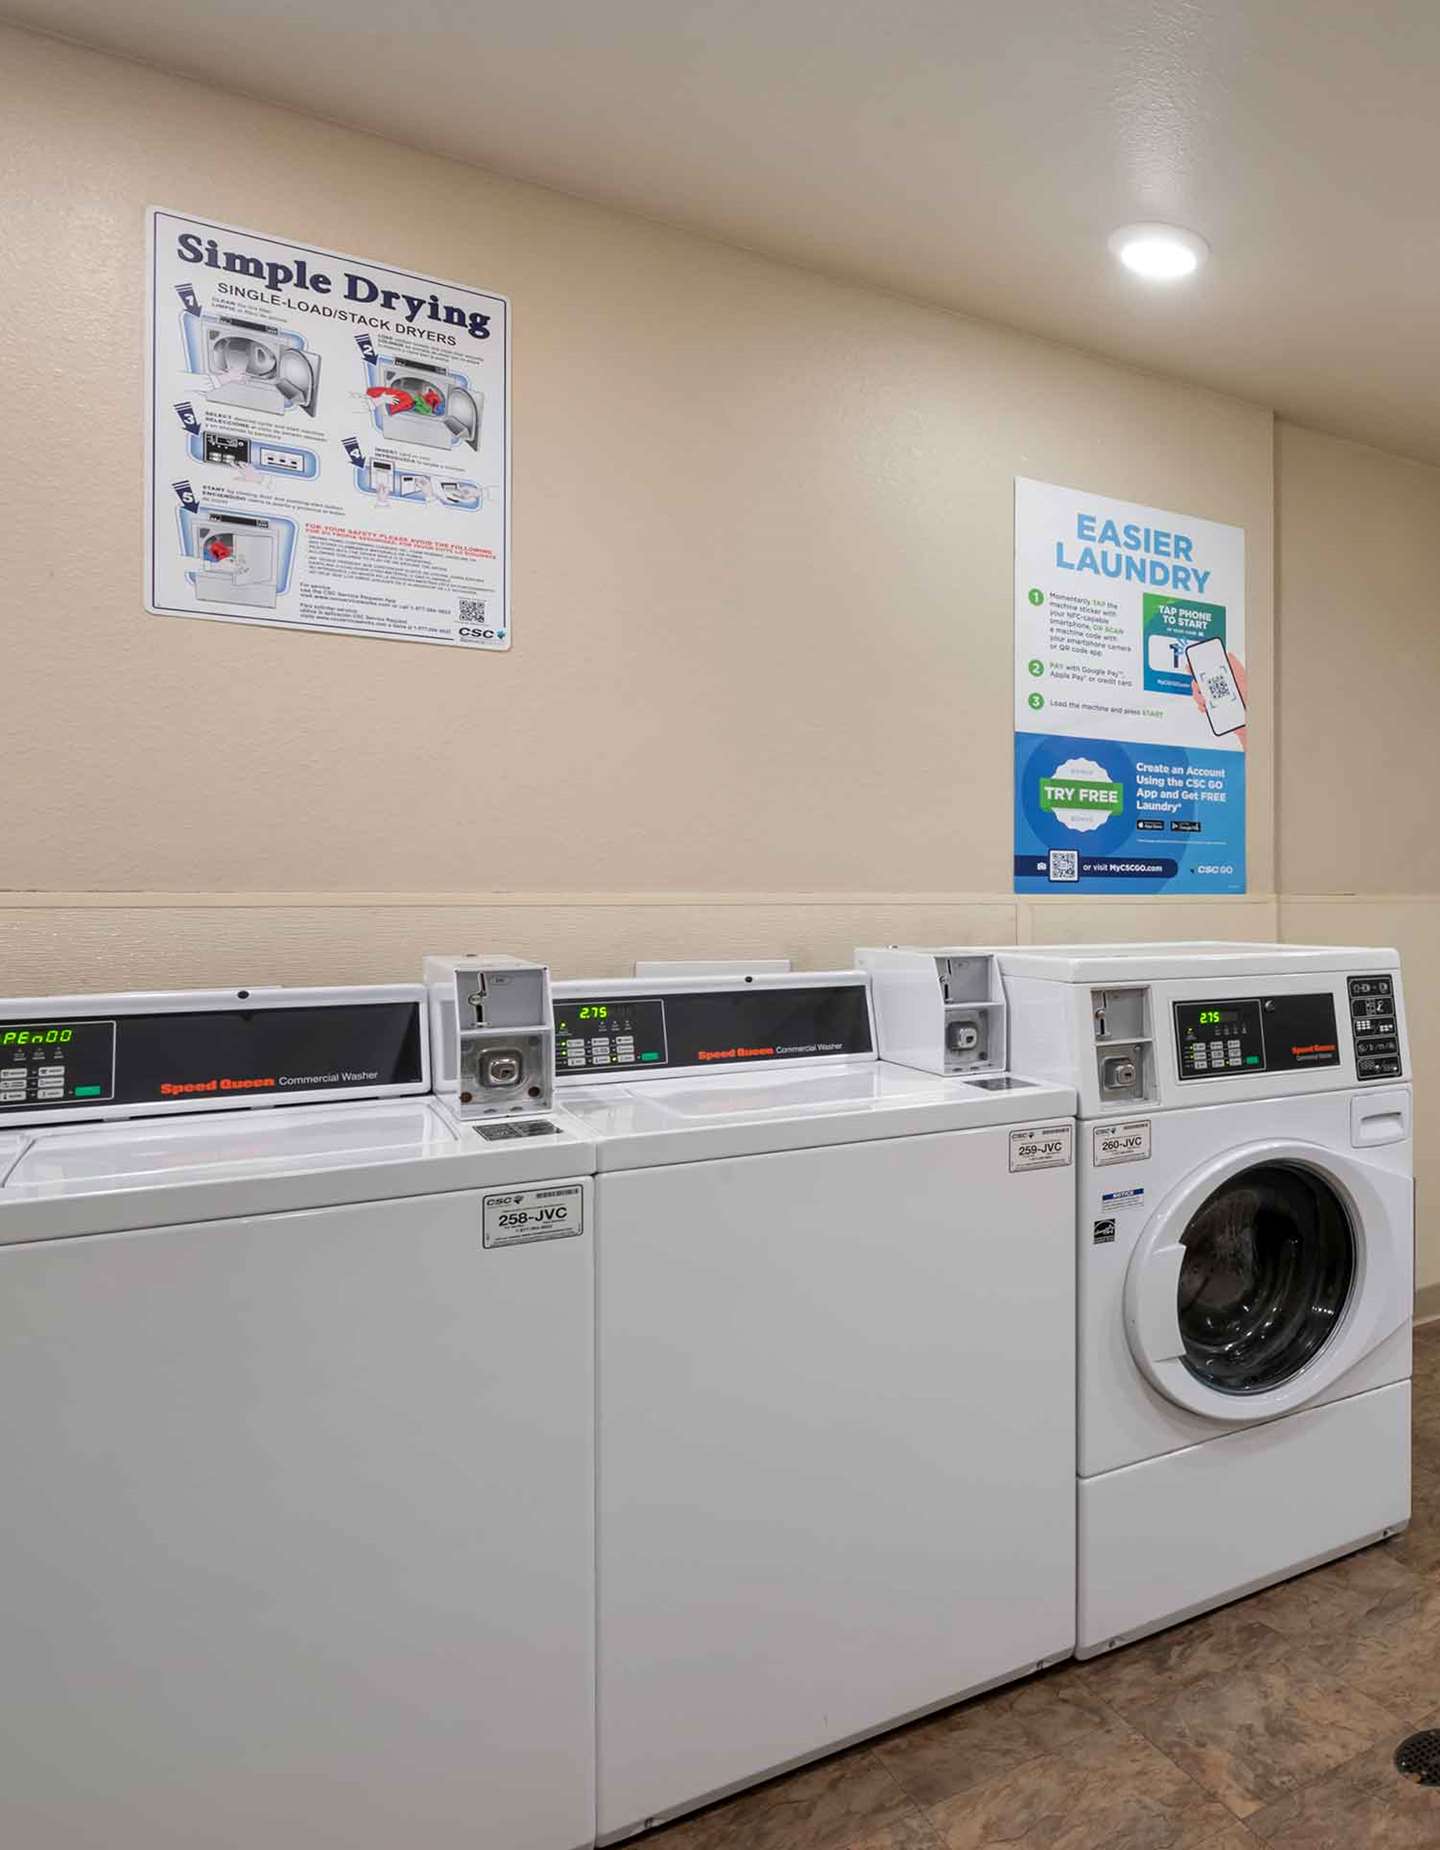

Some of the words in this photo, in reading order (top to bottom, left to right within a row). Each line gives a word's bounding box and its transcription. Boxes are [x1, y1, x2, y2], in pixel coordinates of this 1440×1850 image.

[177, 232, 333, 294] Simple
[344, 272, 491, 340] Drying
[218, 282, 391, 331] SINGLE-LOAD/STACK
[395, 323, 457, 346] DRYERS
[362, 343, 374, 356] 2
[185, 413, 196, 426] 3
[182, 491, 193, 504] 5
[1077, 513, 1194, 562] EASIER
[1056, 541, 1211, 594] LAUNDRY
[1049, 601, 1078, 611] machine
[1106, 601, 1119, 609] the
[1159, 605, 1177, 617] TAP
[1179, 608, 1212, 621] PHONE
[1163, 615, 1175, 625] TO
[1178, 618, 1208, 630] START
[458, 627, 495, 639] CSC
[1055, 628, 1083, 638] machine
[1085, 632, 1102, 640] code
[1072, 646, 1088, 654] code
[1032, 663, 1041, 673] 2
[1066, 664, 1081, 672] with
[1082, 666, 1105, 677] Google
[1049, 671, 1070, 681] Apple
[1097, 676, 1116, 686] credit
[1031, 695, 1040, 706] 3
[1050, 699, 1067, 708] Load
[1069, 701, 1080, 709] the
[1081, 703, 1109, 713] machine
[1110, 706, 1122, 715] and
[1136, 762, 1169, 774] Create
[1171, 766, 1184, 775] an
[1186, 767, 1225, 778] Account
[1136, 775, 1165, 787] Using
[1167, 777, 1183, 787] the
[1186, 778, 1206, 788] CSC
[1208, 780, 1223, 789] GO
[1044, 785, 1075, 801] TRY
[1079, 788, 1119, 803] FREE
[1136, 788, 1158, 799] App
[1160, 788, 1179, 799] and
[1181, 790, 1198, 801] Get
[1200, 791, 1227, 802] FREE
[1093, 863, 1108, 871] visit
[1109, 863, 1163, 873] MyCSCGO.com
[1220, 865, 1233, 875] GO
[697, 1050, 735, 1061] Speed
[737, 1047, 775, 1056] Queen
[776, 1044, 816, 1055] Commercial
[817, 1042, 843, 1051] Washer
[160, 1079, 217, 1096] Speed
[220, 1077, 275, 1090] Queen
[278, 1073, 340, 1087] Commercial
[341, 1070, 379, 1082] Washer
[1019, 1141, 1063, 1156] 259-JVC
[1102, 1136, 1142, 1151] 260-JVC
[486, 1197, 512, 1206] CSC
[498, 1206, 568, 1227] 258-JVC
